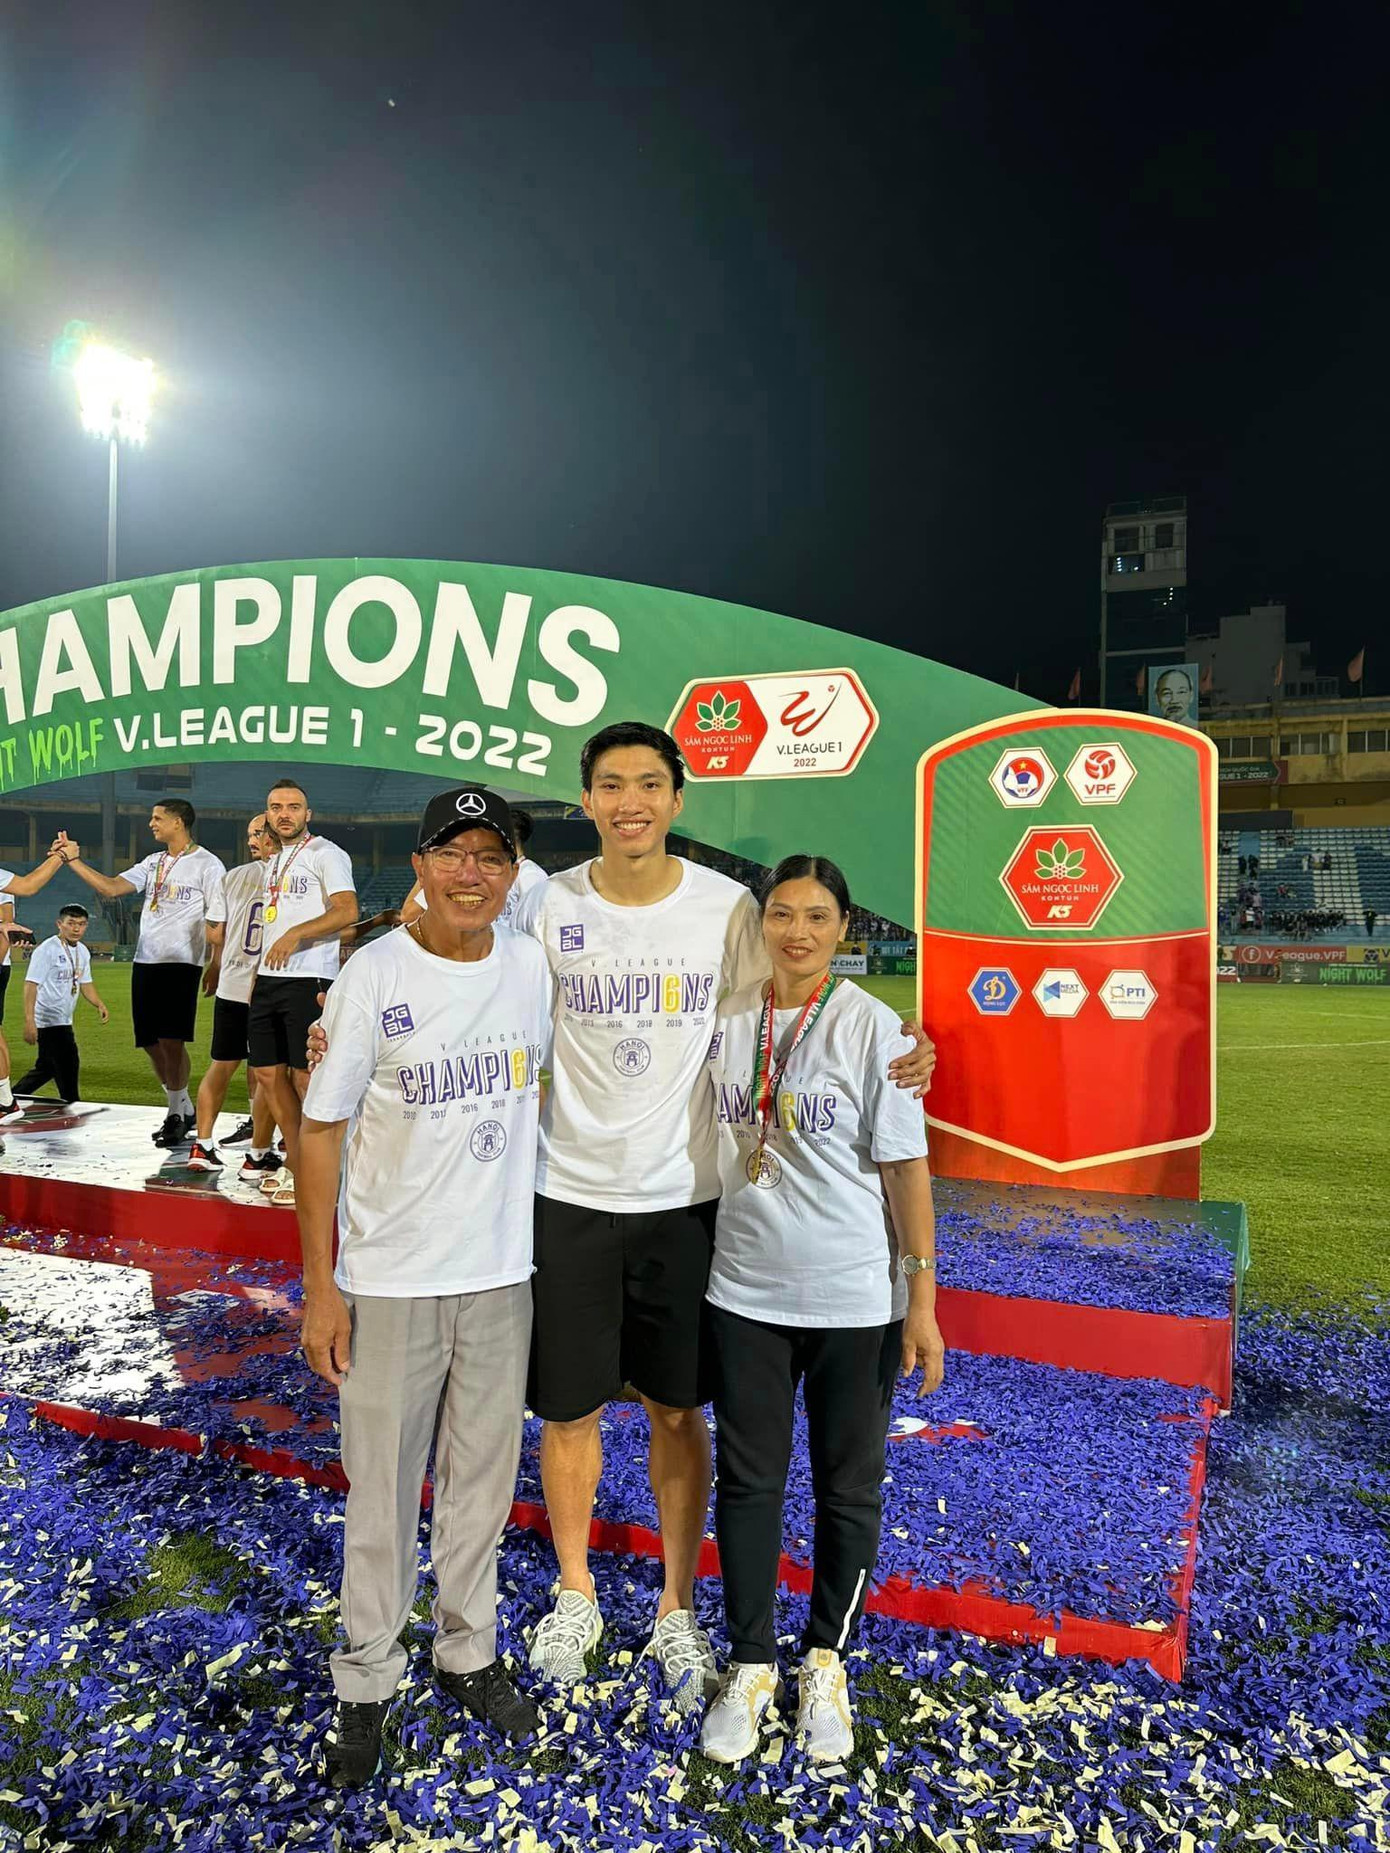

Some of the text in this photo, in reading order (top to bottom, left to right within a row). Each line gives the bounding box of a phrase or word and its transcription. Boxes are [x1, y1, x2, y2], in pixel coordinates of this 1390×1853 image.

[28, 717, 104, 786] WOLF
[113, 705, 330, 753] V.LEAGUE
[351, 708, 364, 748] 1
[415, 714, 552, 777] 2022
[730, 734, 753, 744] LINH
[777, 741, 835, 755] V.LEAGUE
[794, 758, 817, 768] 2022
[1084, 783, 1116, 796] VPF
[1074, 883, 1099, 894] LINH
[1319, 967, 1388, 983] NIGHT WOLF
[1126, 987, 1146, 998] PTI
[384, 1006, 409, 1024] JG
[385, 1020, 412, 1035] BL
[464, 1030, 527, 1048] LEAGUE
[461, 1104, 479, 1114] 2016
